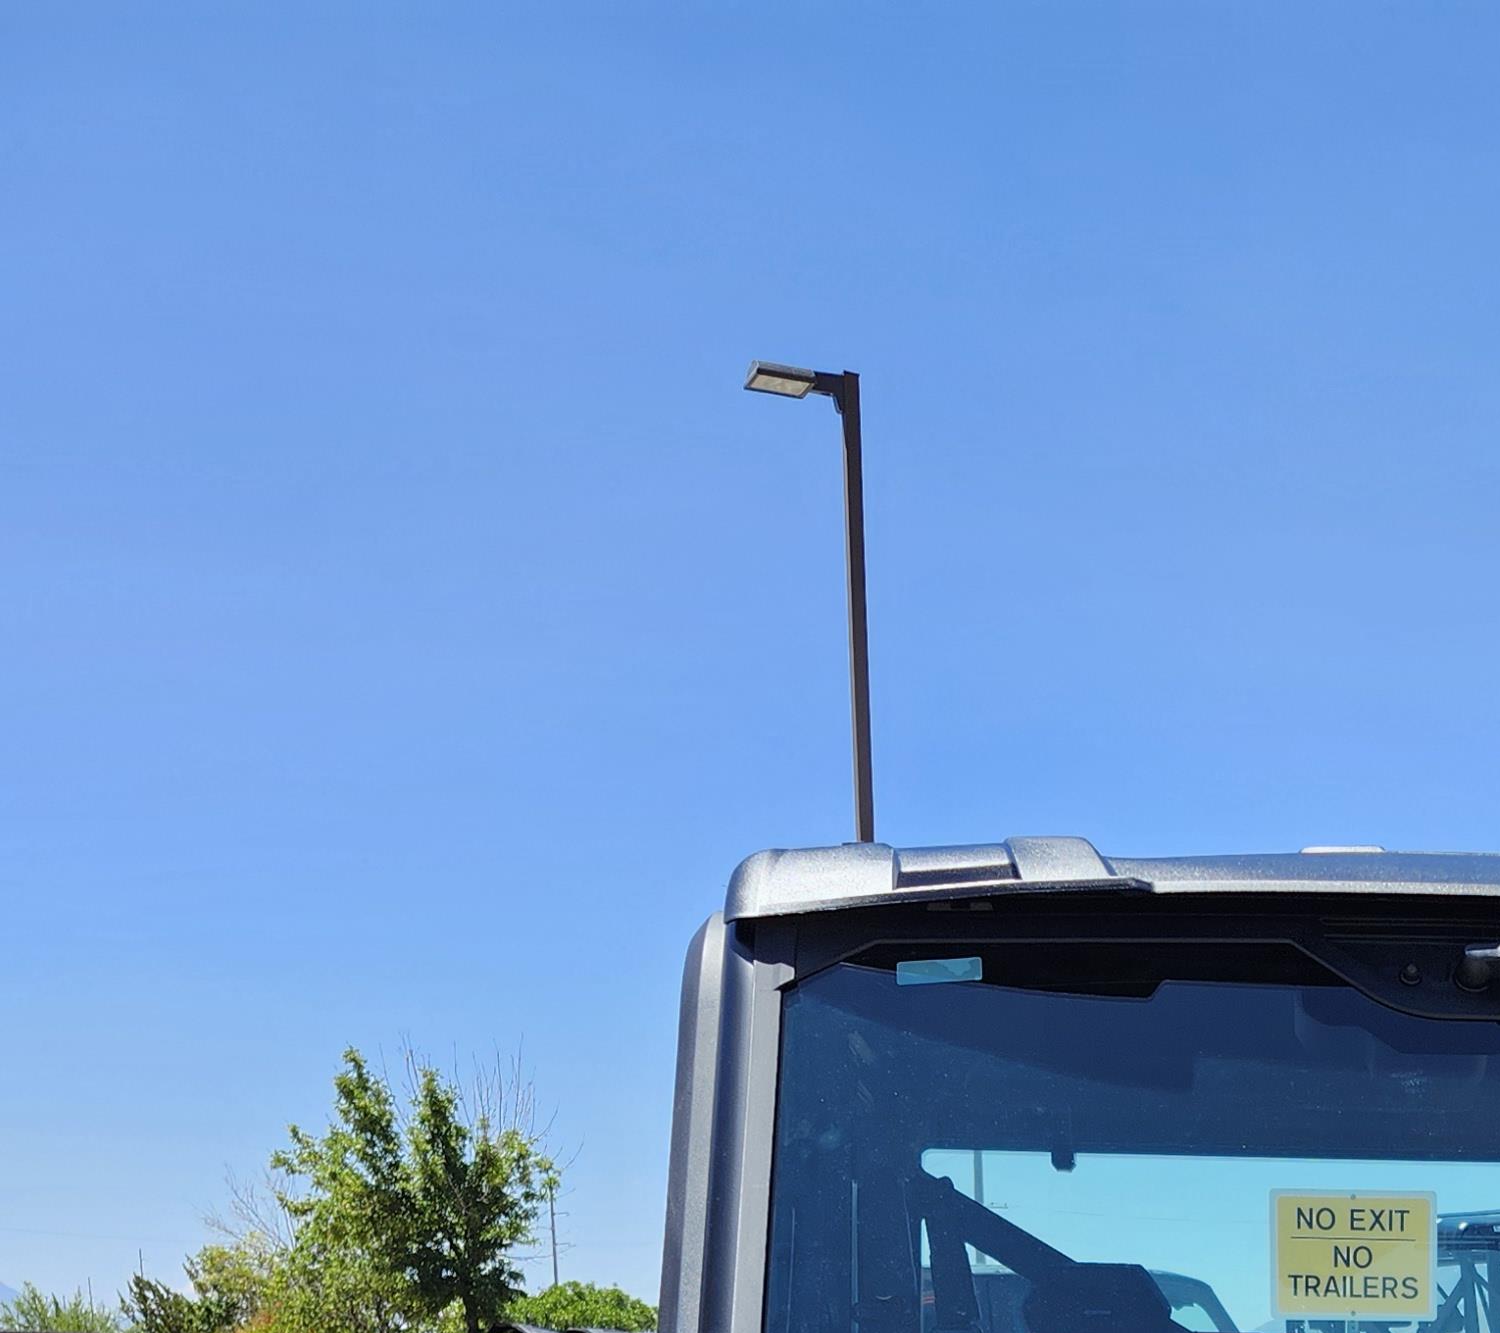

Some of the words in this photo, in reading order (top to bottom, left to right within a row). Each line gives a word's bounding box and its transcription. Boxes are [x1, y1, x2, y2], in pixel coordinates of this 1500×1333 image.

[1297, 1207, 1336, 1230] NO
[1349, 1209, 1410, 1232] EXIT
[1333, 1245, 1373, 1268] NO
[1288, 1274, 1418, 1299] TRAILERS
